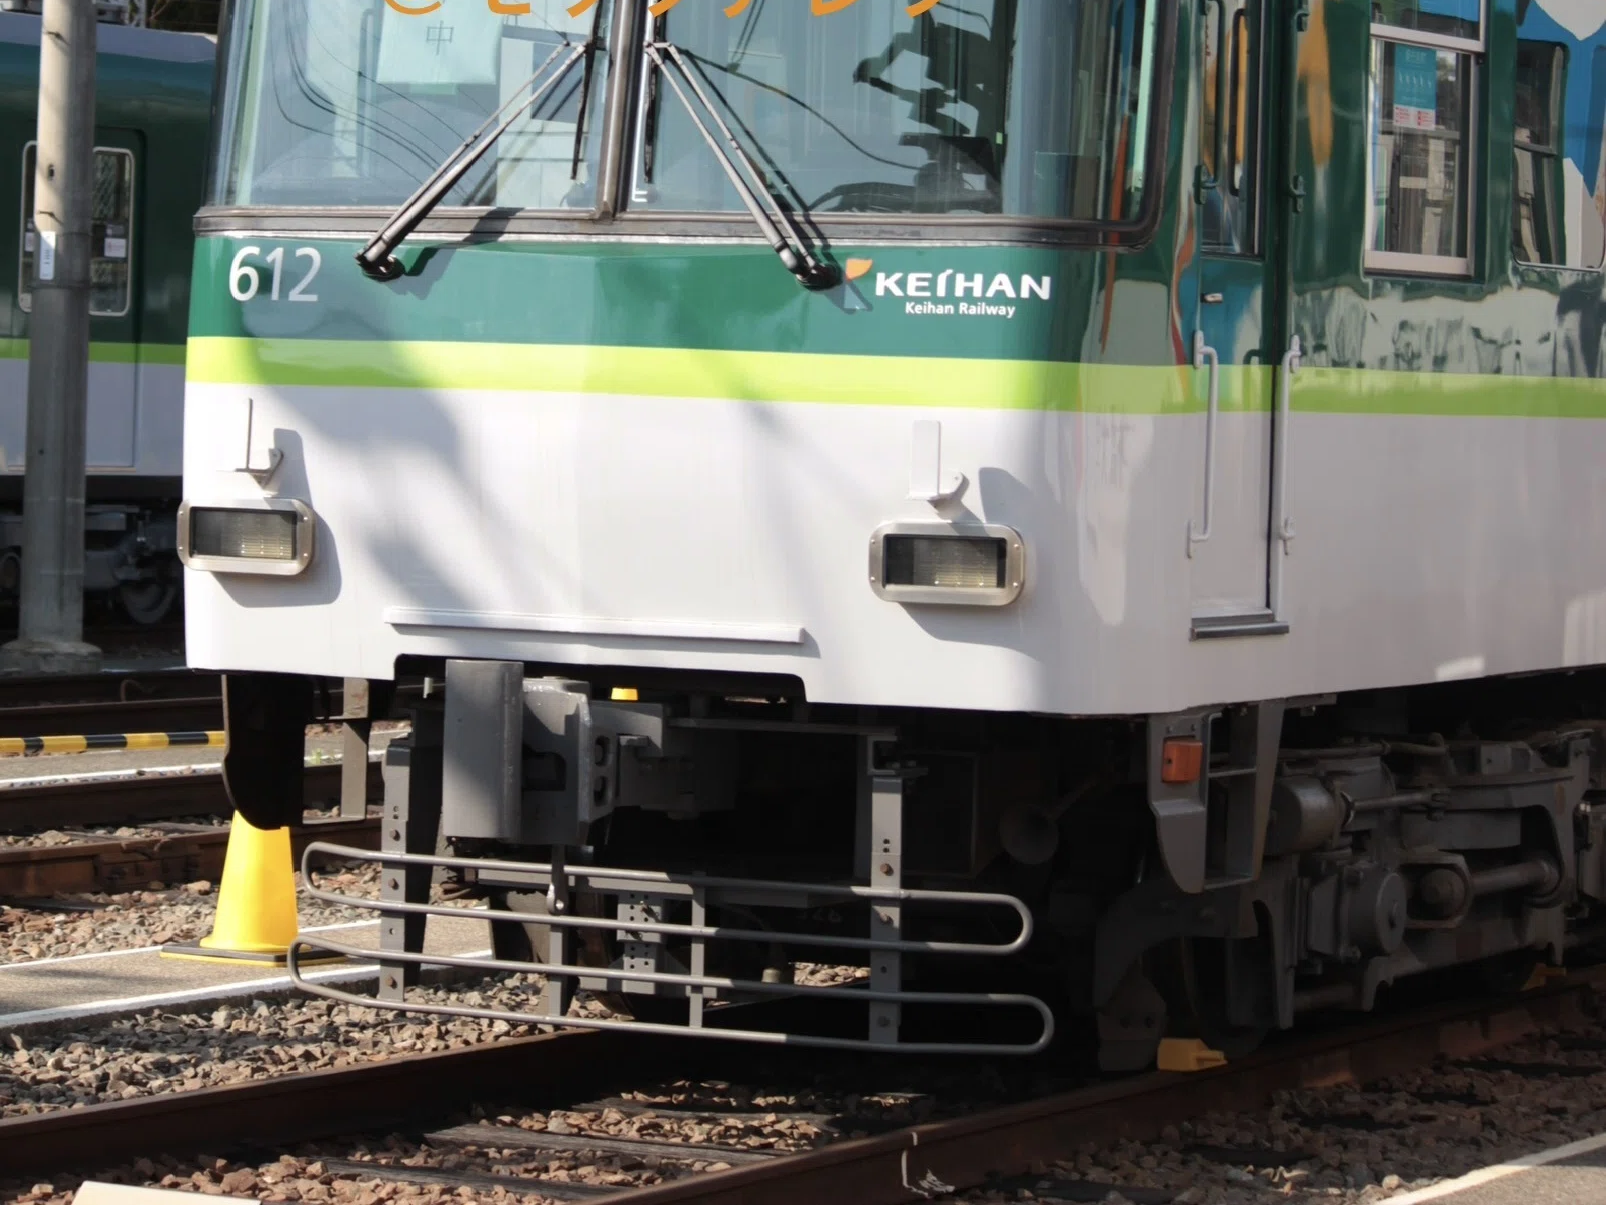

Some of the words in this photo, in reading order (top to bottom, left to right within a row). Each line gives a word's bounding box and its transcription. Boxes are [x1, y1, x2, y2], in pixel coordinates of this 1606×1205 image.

[229, 246, 322, 301] 612
[875, 269, 1051, 300] KEIHAN
[905, 302, 954, 315] Keihan
[959, 302, 1016, 318] Railway
